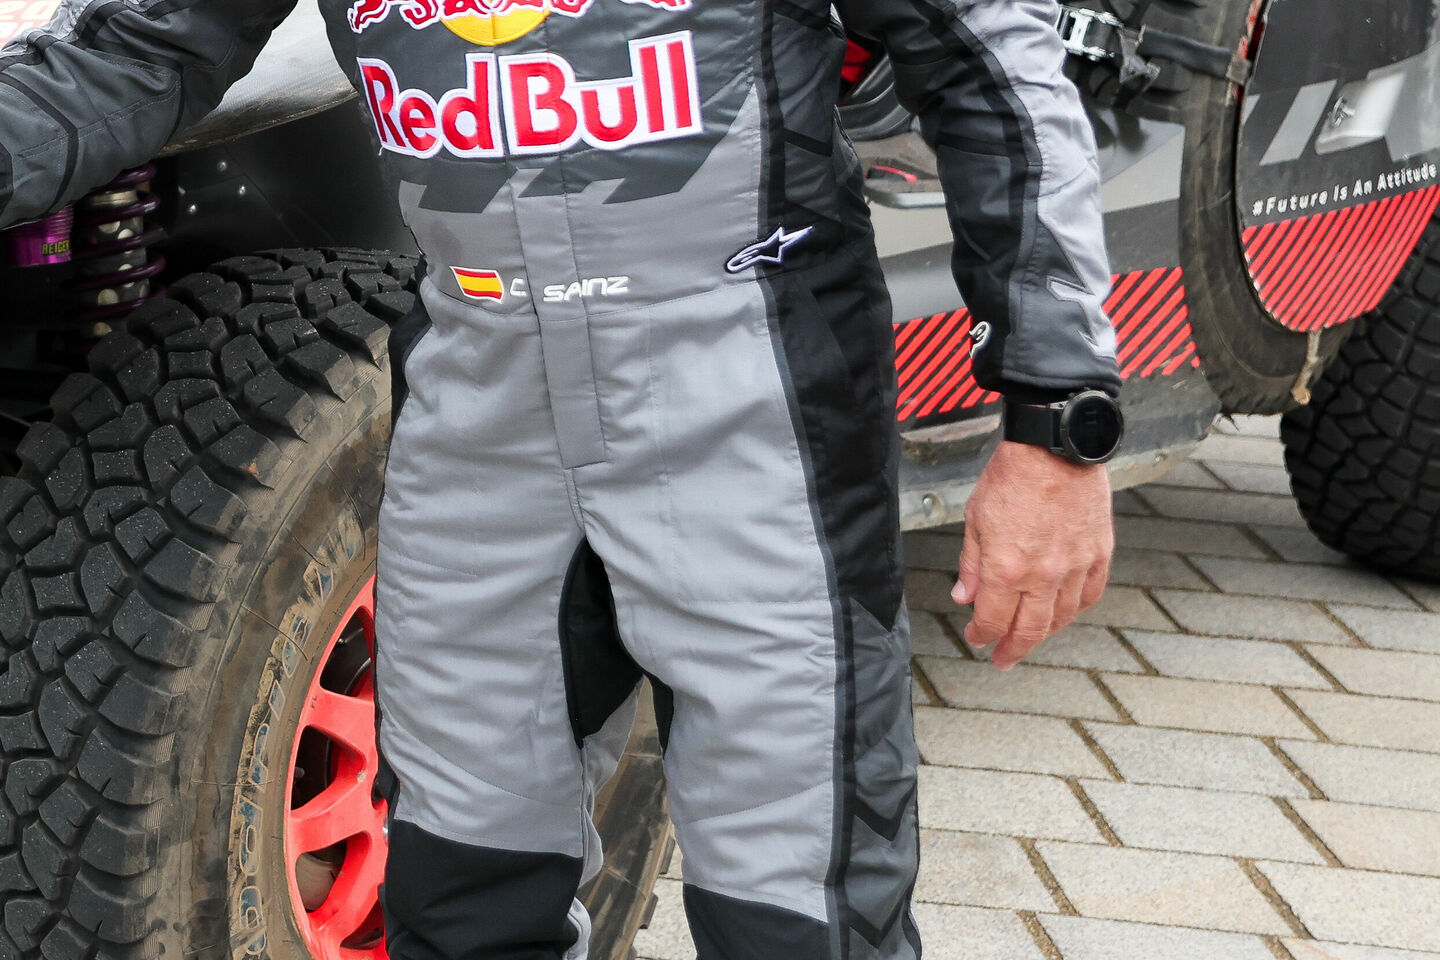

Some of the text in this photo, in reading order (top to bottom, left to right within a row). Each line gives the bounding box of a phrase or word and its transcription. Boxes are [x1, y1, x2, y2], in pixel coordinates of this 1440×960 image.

[358, 31, 701, 157] Red Bull
[1352, 178, 1373, 198] An
[1377, 161, 1437, 191] Attitude
[543, 276, 629, 302] SAINZ
